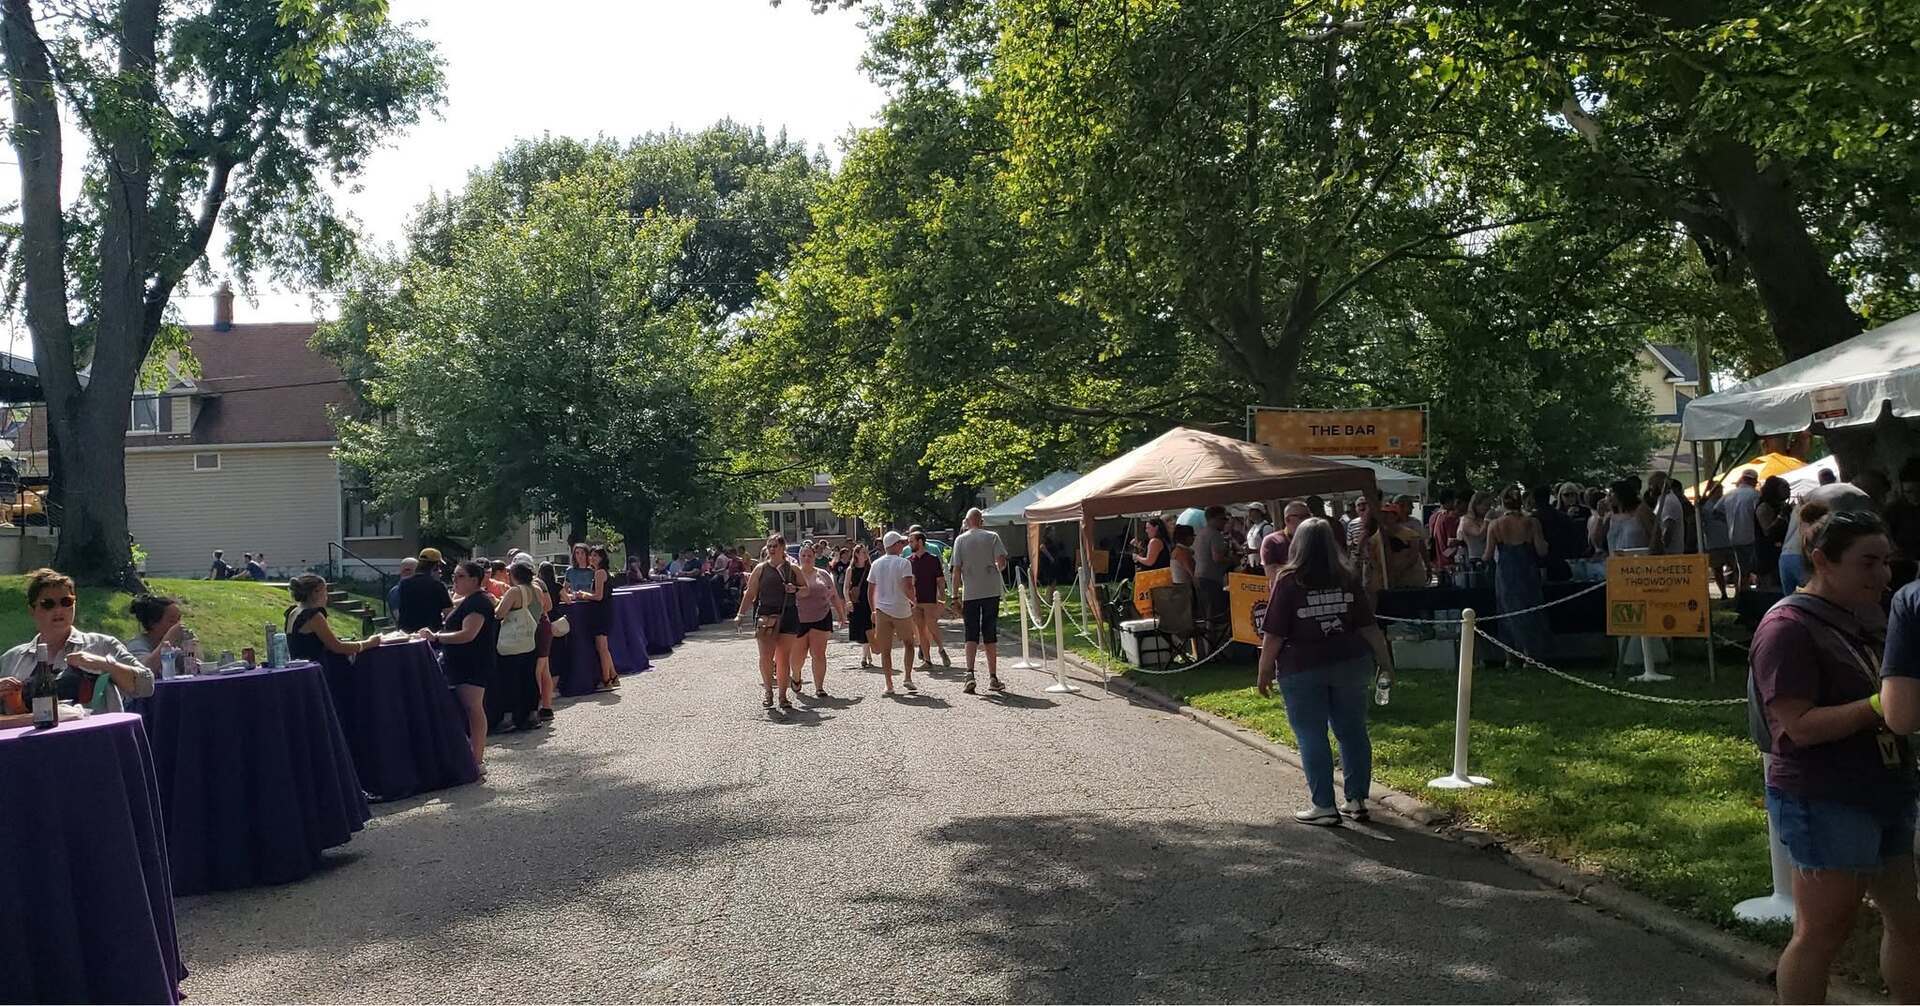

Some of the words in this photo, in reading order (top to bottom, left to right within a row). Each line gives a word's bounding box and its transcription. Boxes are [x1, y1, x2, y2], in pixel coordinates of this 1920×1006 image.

[1308, 425, 1340, 436] THE
[1345, 424, 1376, 436] BAR
[1240, 582, 1265, 592] CHEESE
[1625, 576, 1691, 587] THROWDOWN
